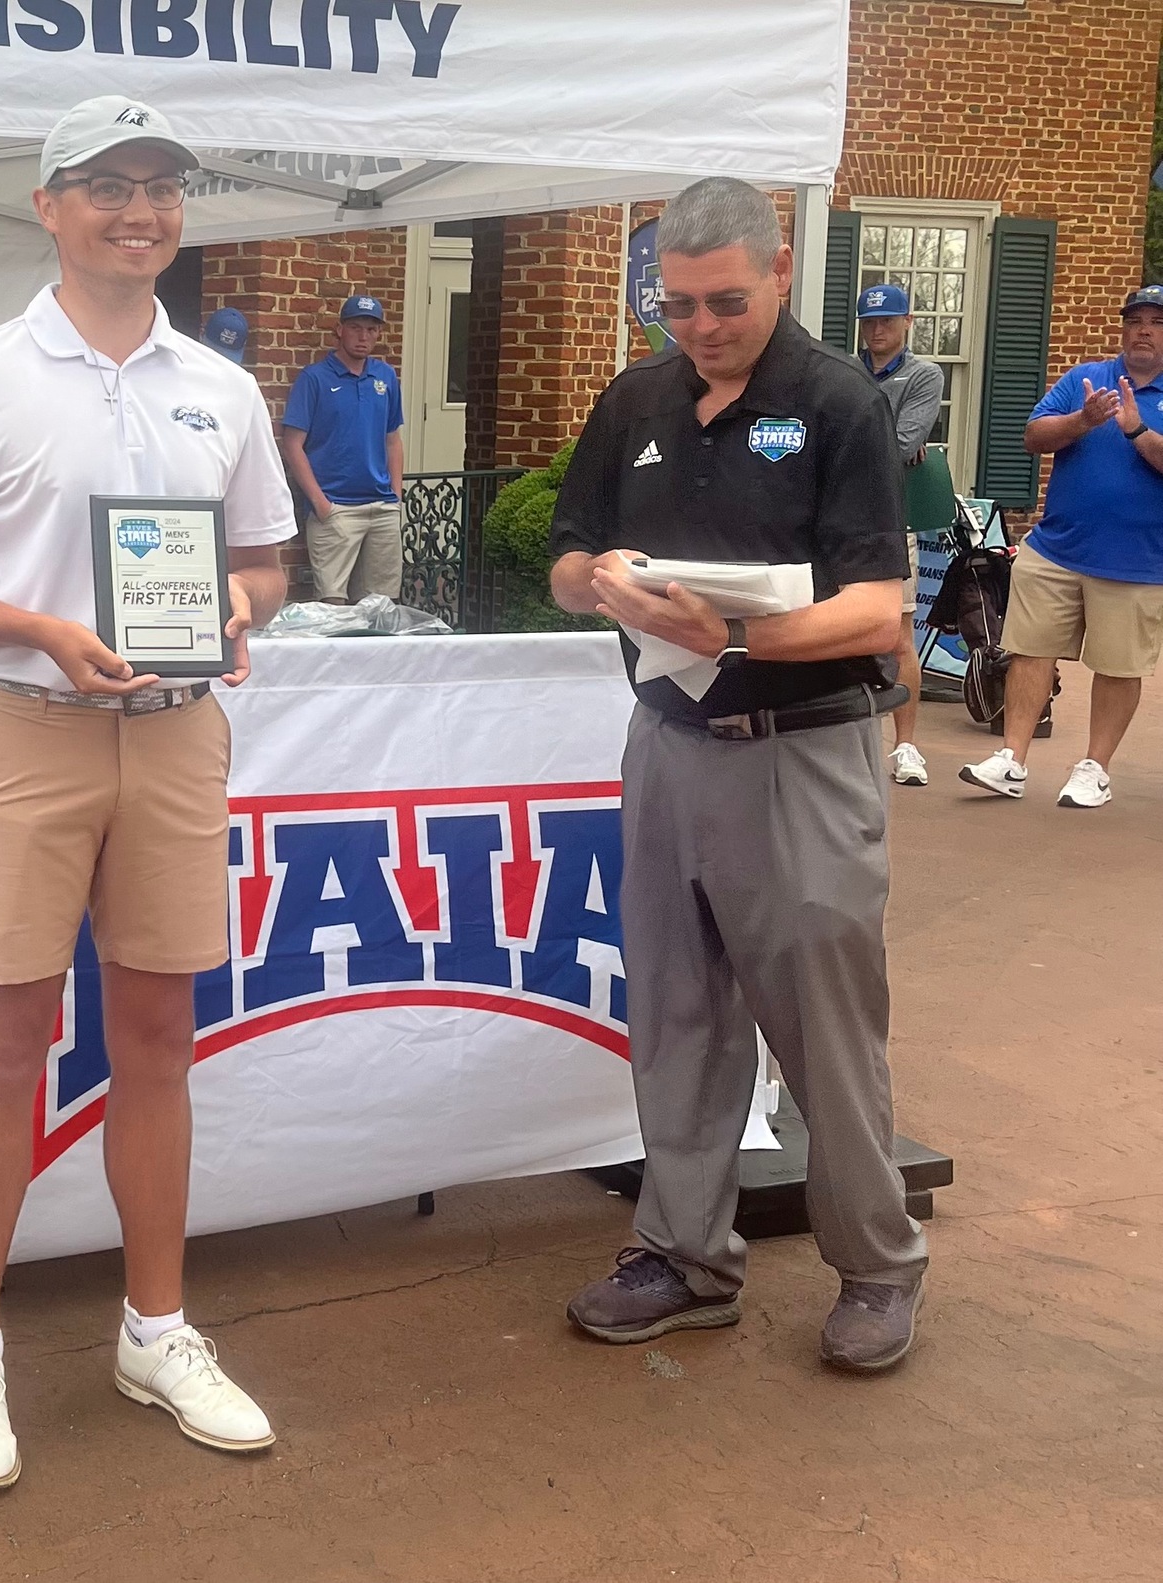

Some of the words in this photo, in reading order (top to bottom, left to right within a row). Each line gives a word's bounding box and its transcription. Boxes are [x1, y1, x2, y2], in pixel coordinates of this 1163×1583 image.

[751, 431, 803, 447] STATES
[118, 530, 160, 544] STATES
[165, 531, 190, 539] MEN'S
[165, 544, 196, 555] GOLF
[122, 581, 212, 591] ALL-CONFERENCE
[122, 592, 165, 605] FIRST
[170, 592, 213, 606] TEAM
